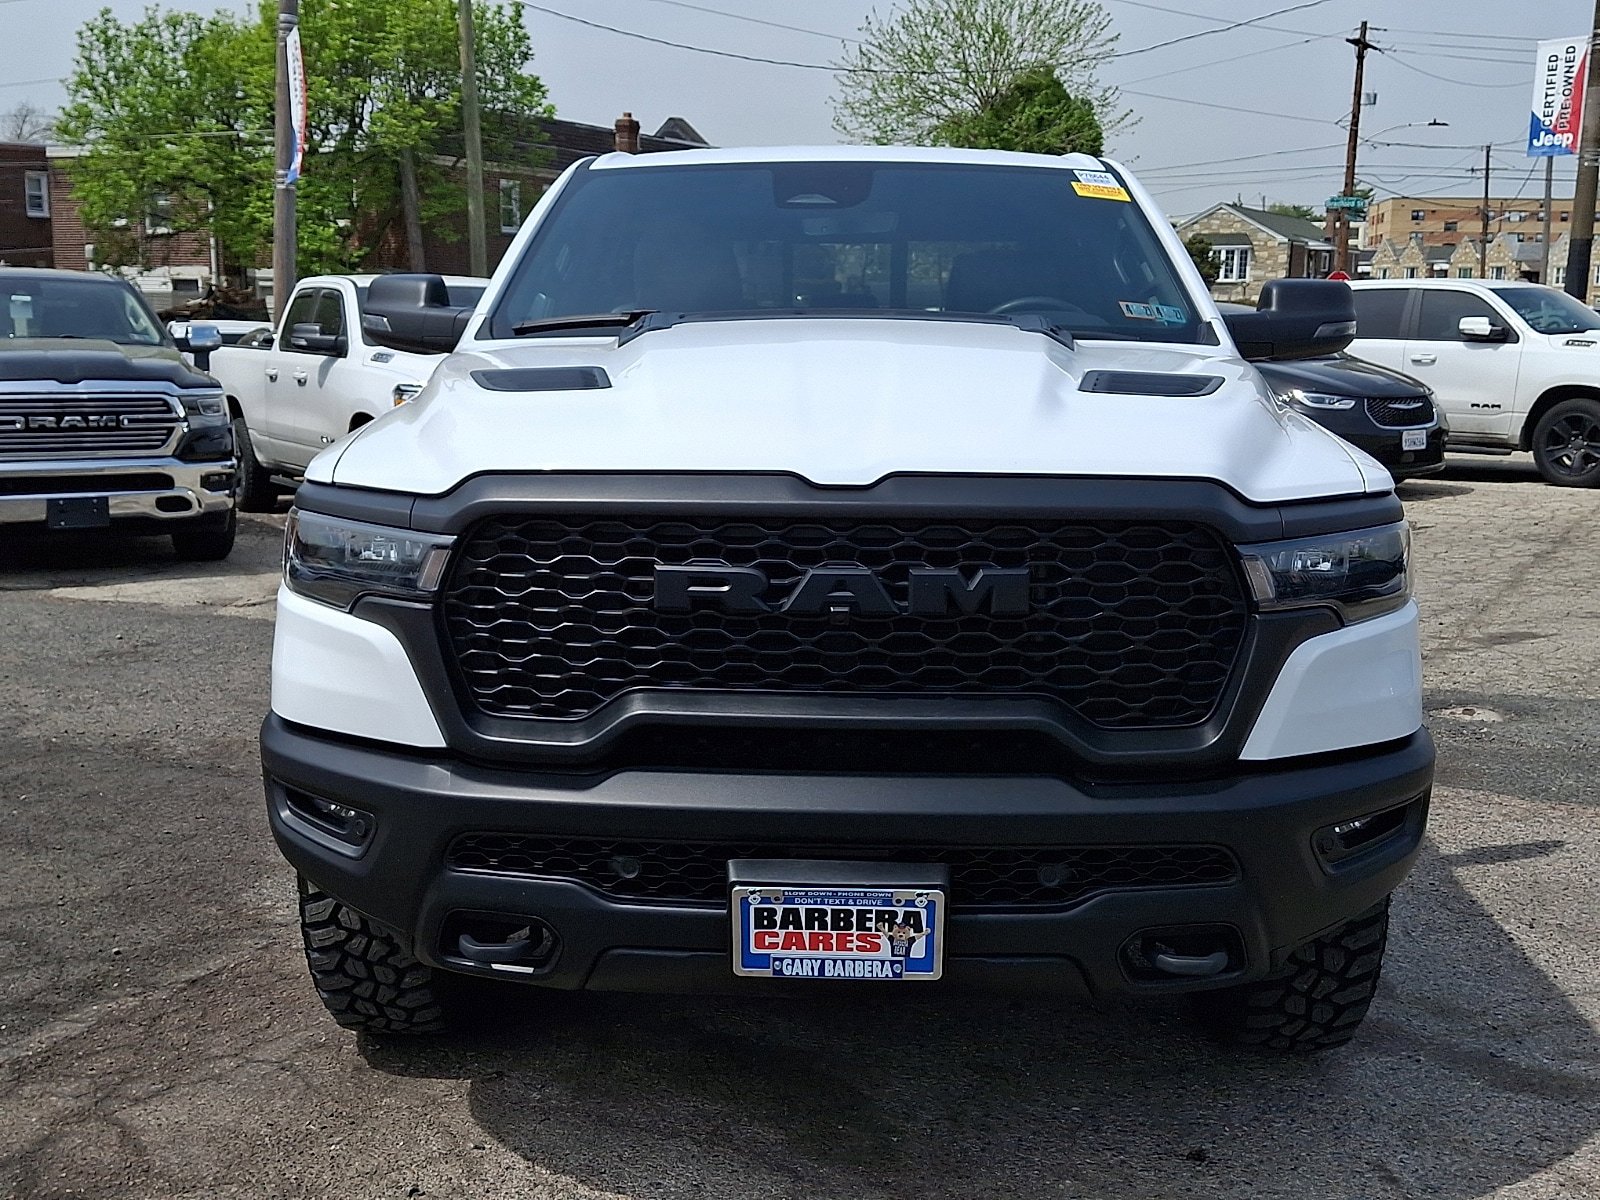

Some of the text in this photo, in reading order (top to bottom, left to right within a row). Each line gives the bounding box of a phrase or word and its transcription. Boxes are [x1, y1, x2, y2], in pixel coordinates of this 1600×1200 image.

[1542, 54, 1559, 127] CERTIFIED
[1532, 131, 1574, 148] Jeep
[28, 415, 117, 429] RAM
[653, 564, 1030, 615] RAM
[794, 897, 823, 905] DON'T
[856, 898, 883, 906] DRIVE
[753, 907, 924, 933] BARBERA
[754, 931, 882, 953] CARES
[782, 958, 893, 978] GARY BARBERA
